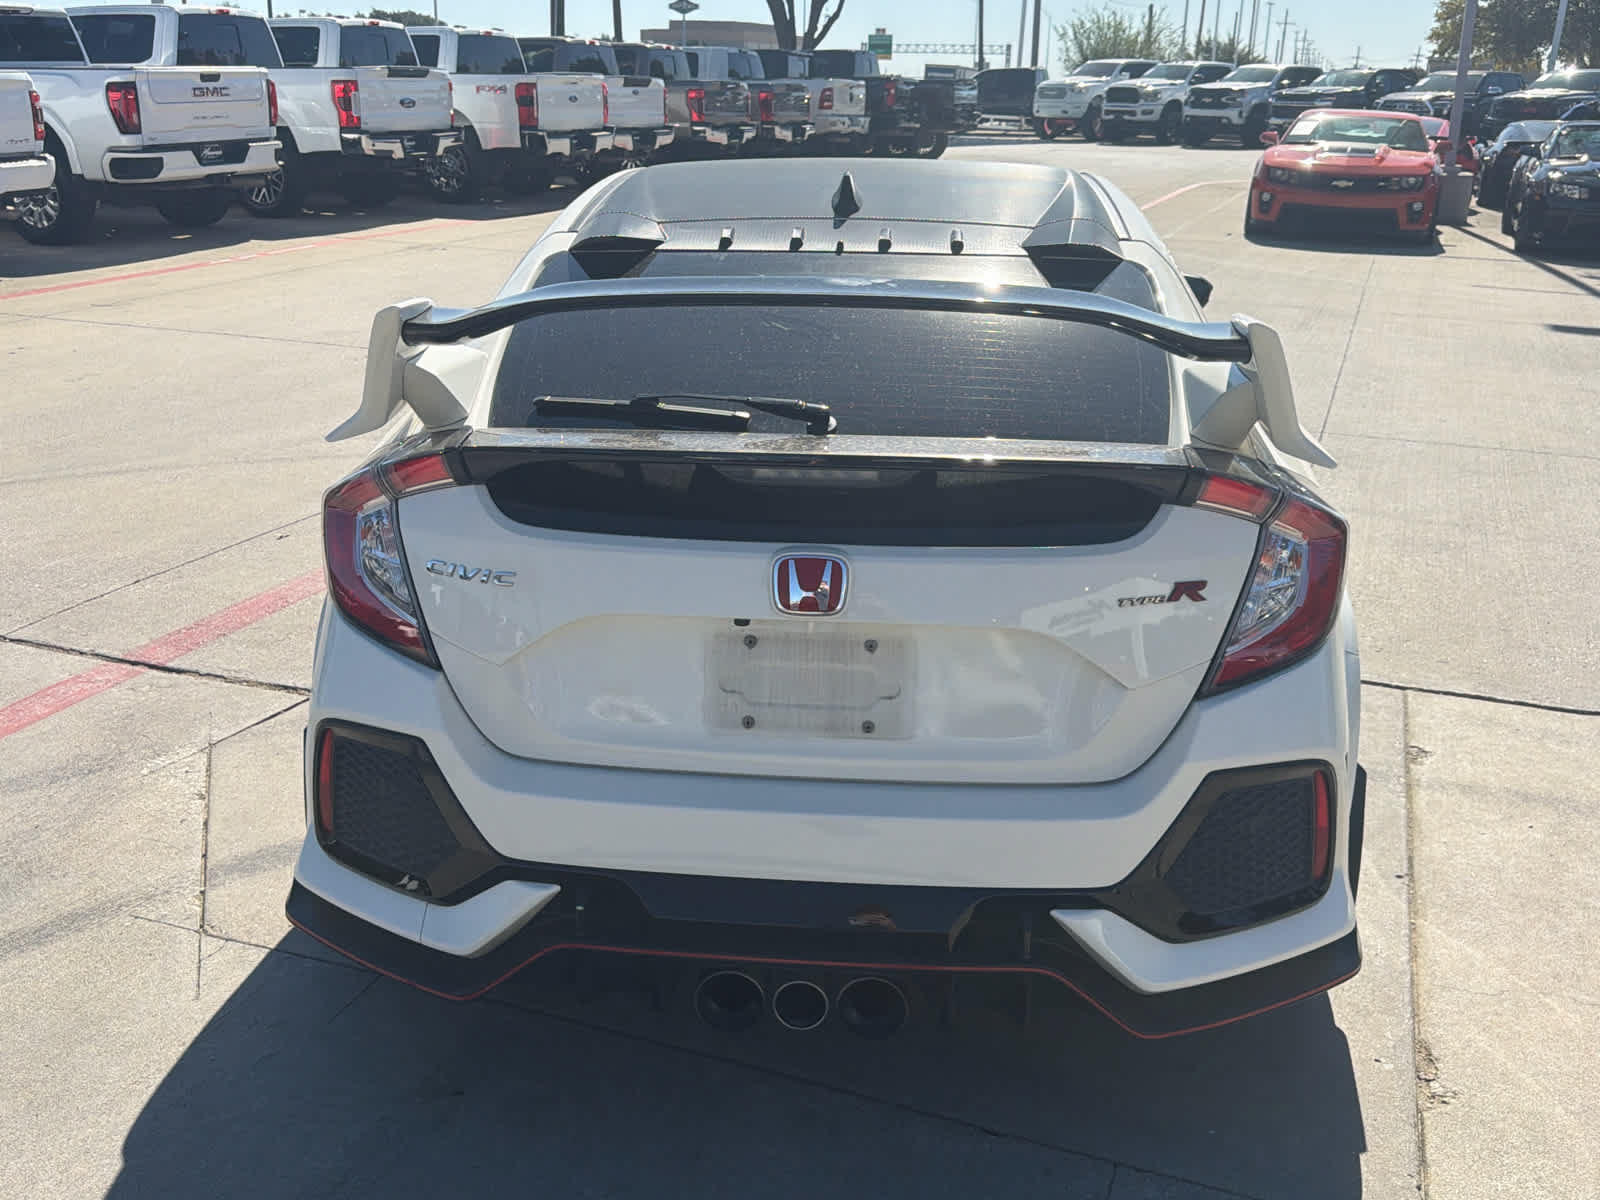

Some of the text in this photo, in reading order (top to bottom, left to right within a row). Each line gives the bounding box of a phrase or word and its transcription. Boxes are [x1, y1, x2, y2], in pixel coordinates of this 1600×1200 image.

[192, 87, 230, 97] GMC
[476, 85, 508, 95] FX4
[426, 559, 517, 587] CIVIC
